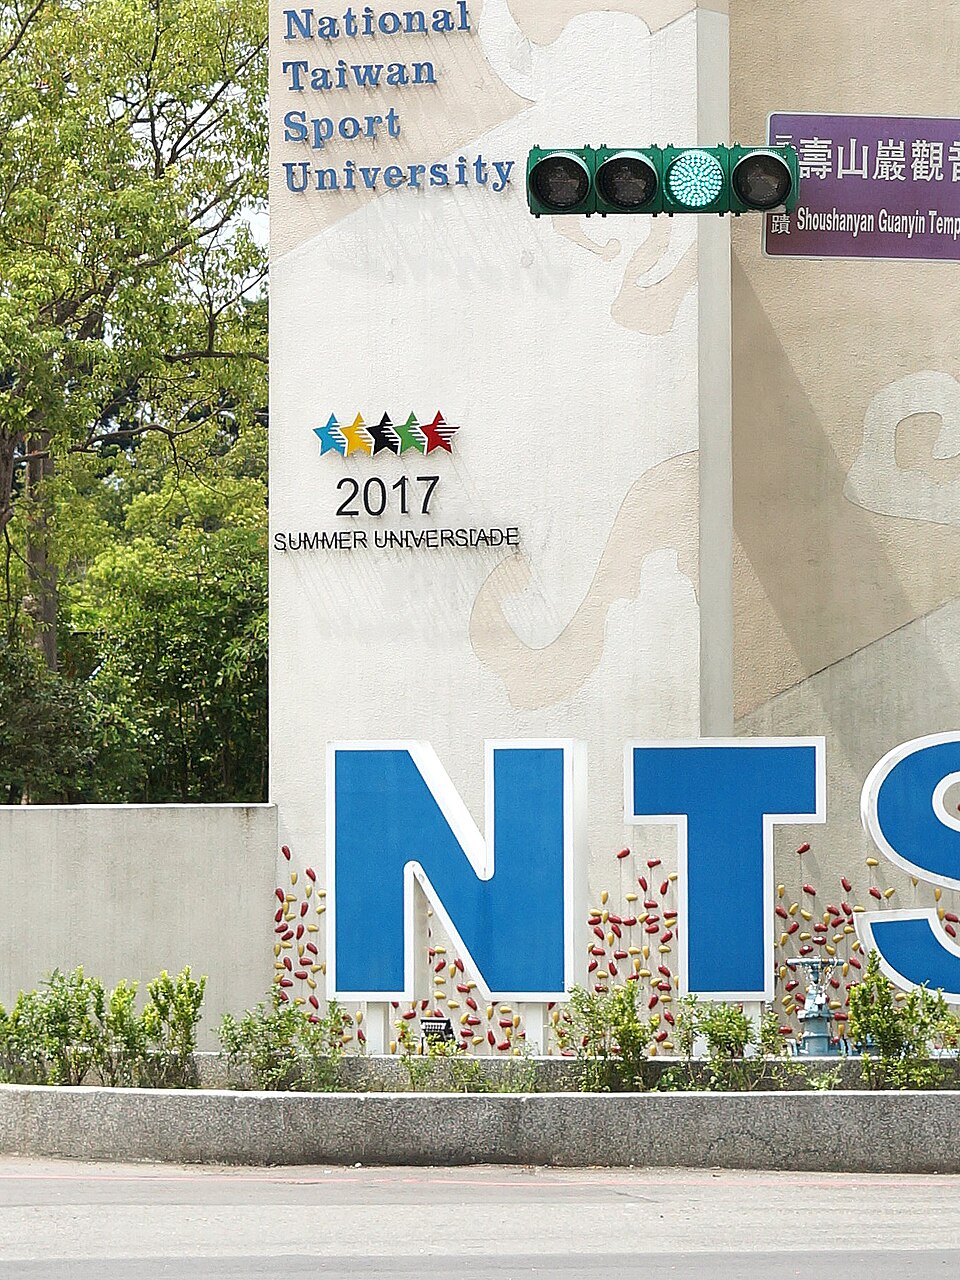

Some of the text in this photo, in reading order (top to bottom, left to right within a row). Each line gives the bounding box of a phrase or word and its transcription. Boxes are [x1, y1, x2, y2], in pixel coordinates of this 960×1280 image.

[283, 1, 470, 39] National
[282, 59, 437, 91] Taiwan
[284, 107, 401, 149] Sport
[282, 155, 515, 192] University
[797, 206, 875, 238] Shoushanyan
[878, 208, 926, 239] Guanyin
[335, 475, 440, 517] 2017
[273, 527, 520, 552] SUMMER UNIVERSIADE
